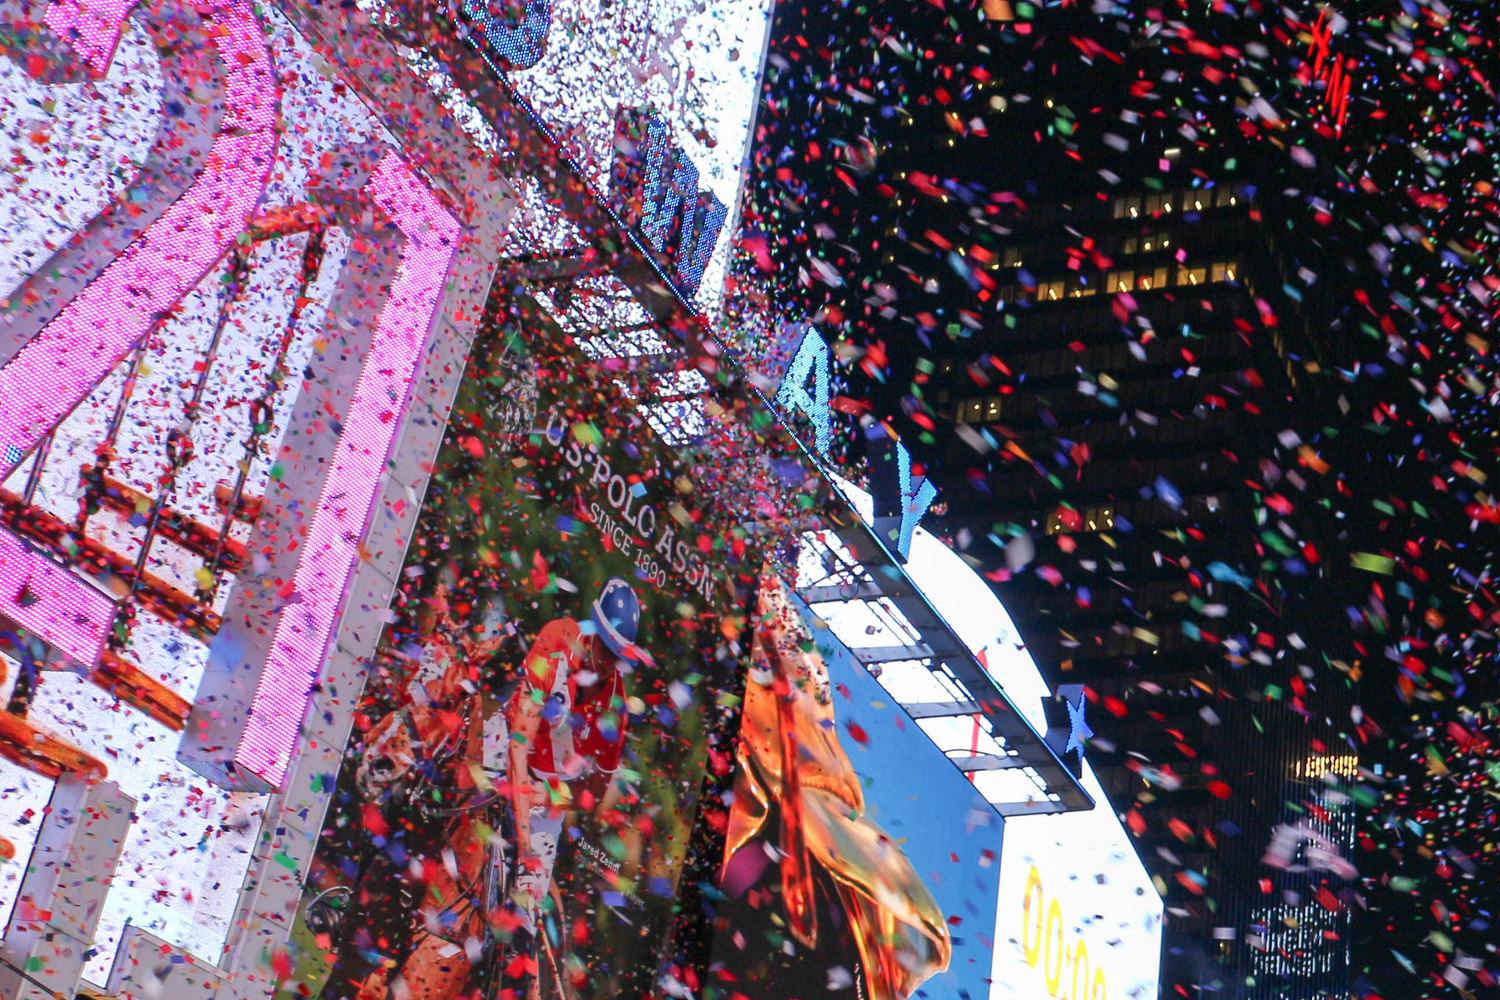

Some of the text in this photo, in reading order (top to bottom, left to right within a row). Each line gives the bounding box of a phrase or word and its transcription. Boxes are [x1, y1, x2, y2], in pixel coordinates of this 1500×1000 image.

[589, 455, 656, 538] POLO
[588, 502, 666, 589] SINCE 1890
[577, 836, 600, 859] Jared
